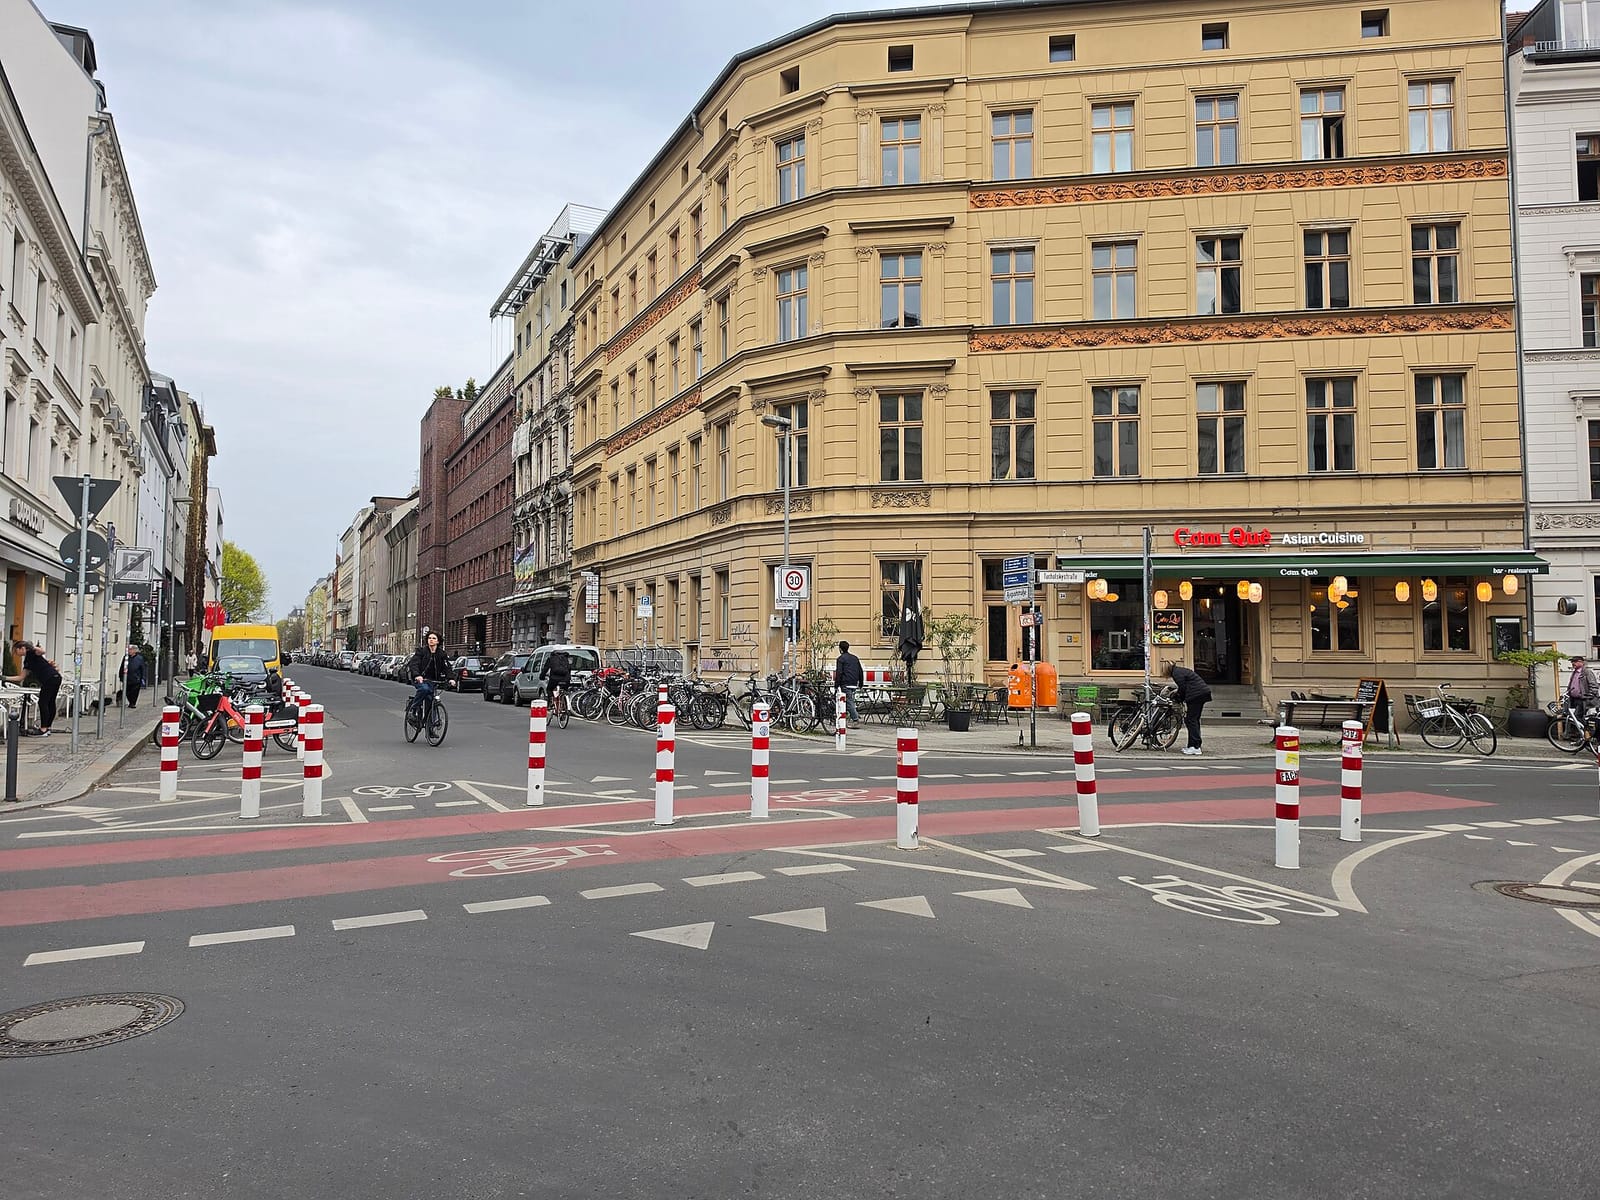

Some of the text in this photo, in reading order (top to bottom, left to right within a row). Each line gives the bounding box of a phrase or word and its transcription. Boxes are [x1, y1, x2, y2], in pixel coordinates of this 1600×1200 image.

[1282, 532, 1364, 545] Asian Cuisine
[789, 575, 800, 586] 30
